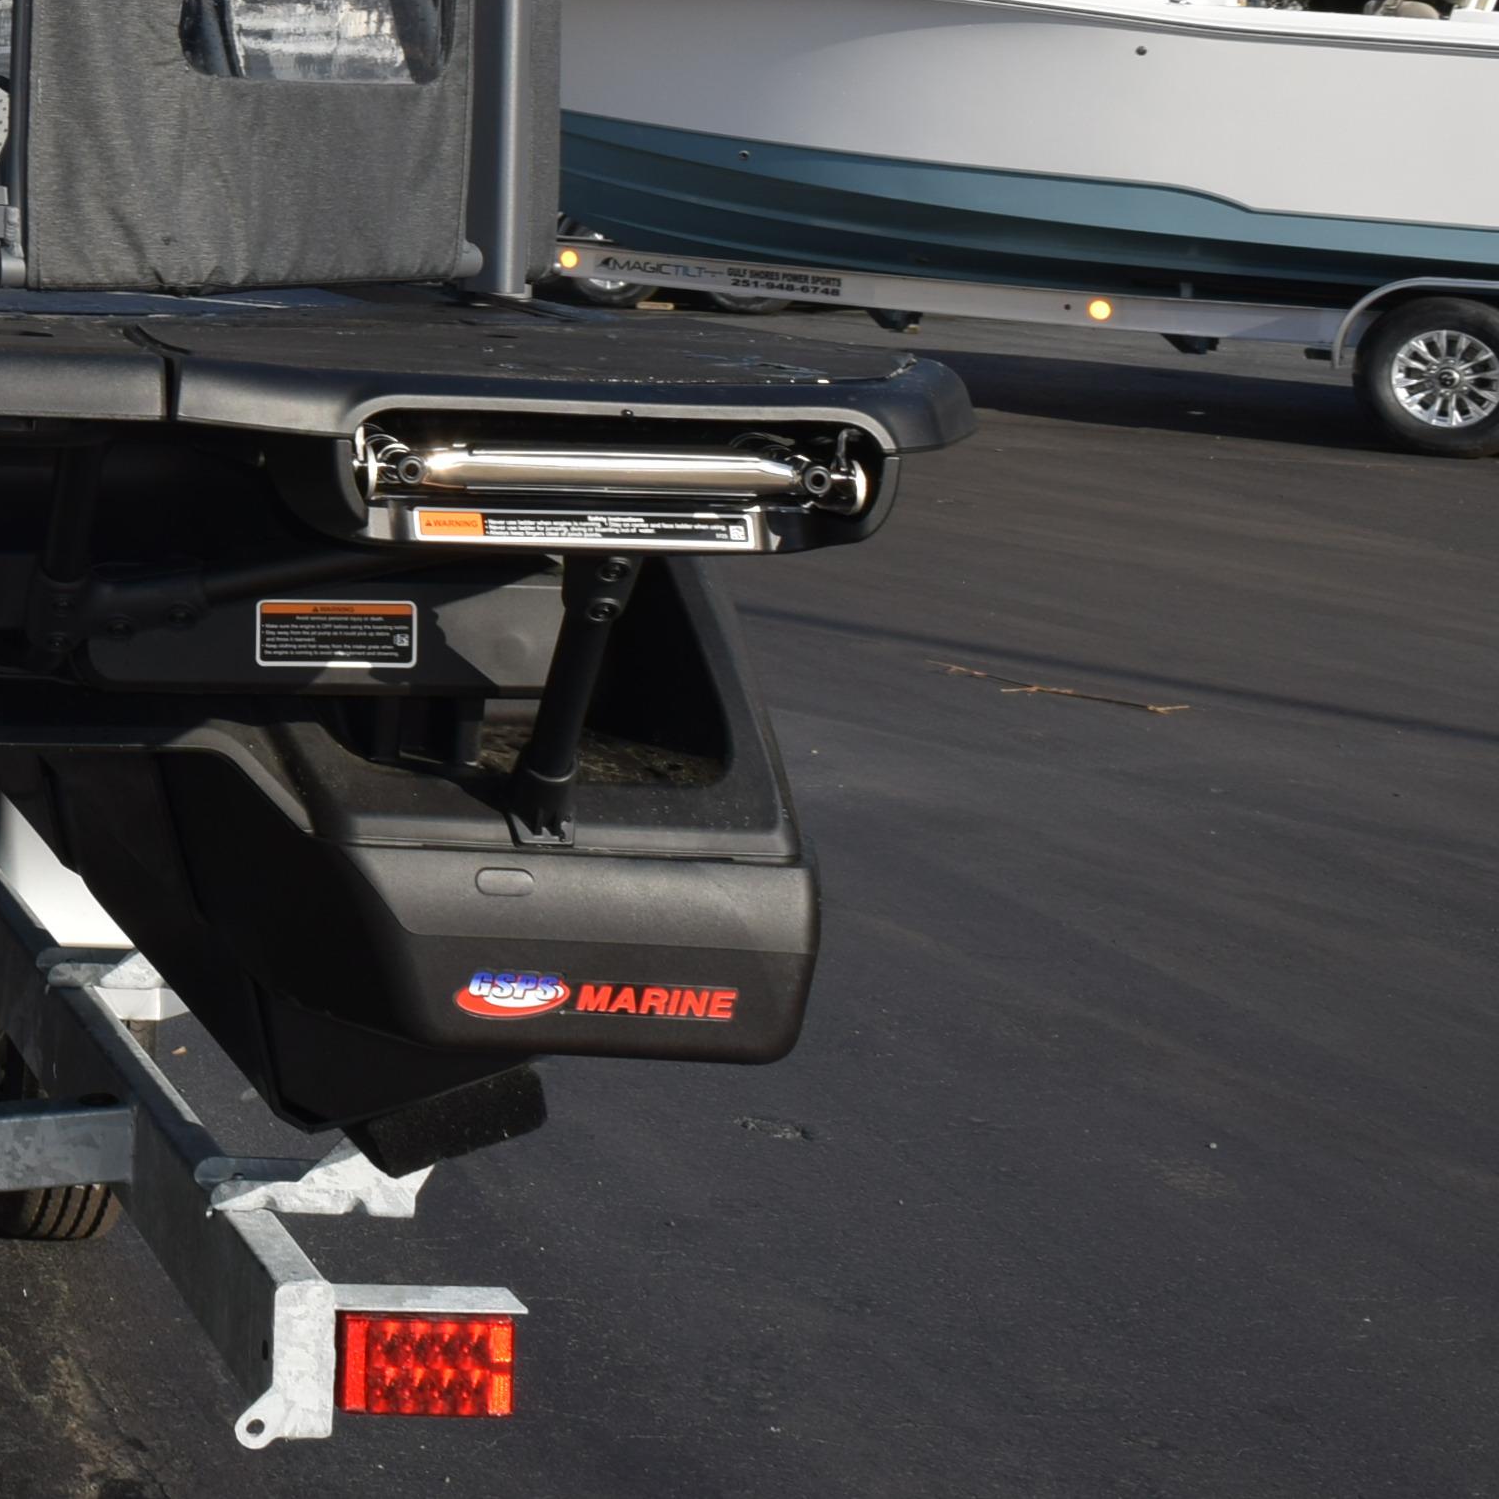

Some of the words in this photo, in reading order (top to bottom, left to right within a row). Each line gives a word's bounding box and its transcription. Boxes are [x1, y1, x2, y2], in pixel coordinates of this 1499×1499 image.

[731, 278, 840, 297] 251-948-6748
[434, 519, 478, 527] WARNING
[468, 971, 560, 1000] GSPS
[576, 984, 736, 1019] MARINE
